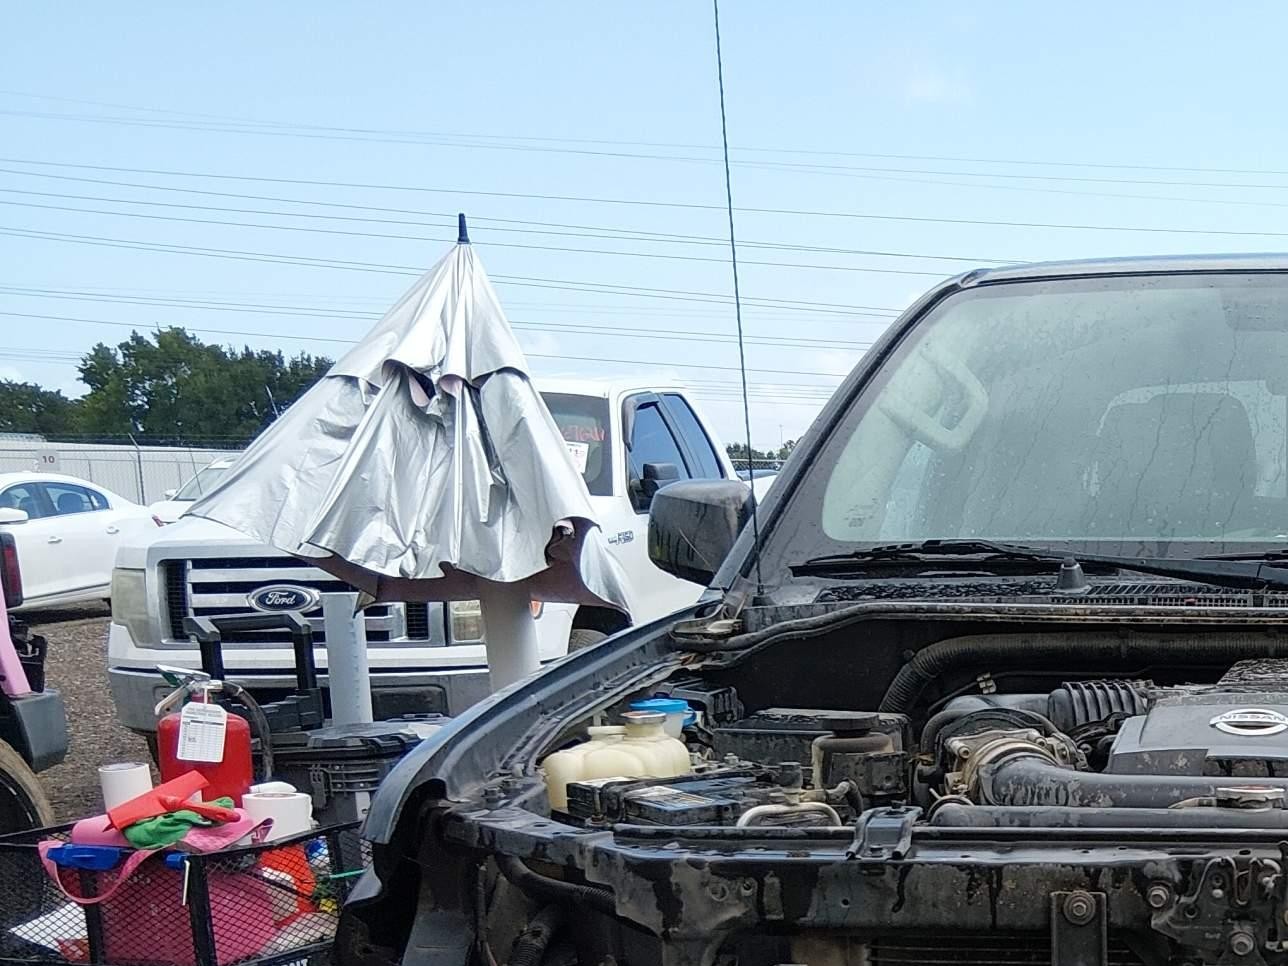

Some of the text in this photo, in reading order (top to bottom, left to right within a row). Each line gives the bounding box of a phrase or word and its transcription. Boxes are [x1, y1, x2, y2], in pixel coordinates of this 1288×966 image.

[42, 455, 55, 464] 10
[265, 591, 297, 605] Ford
[1220, 714, 1286, 722] NISSAN
